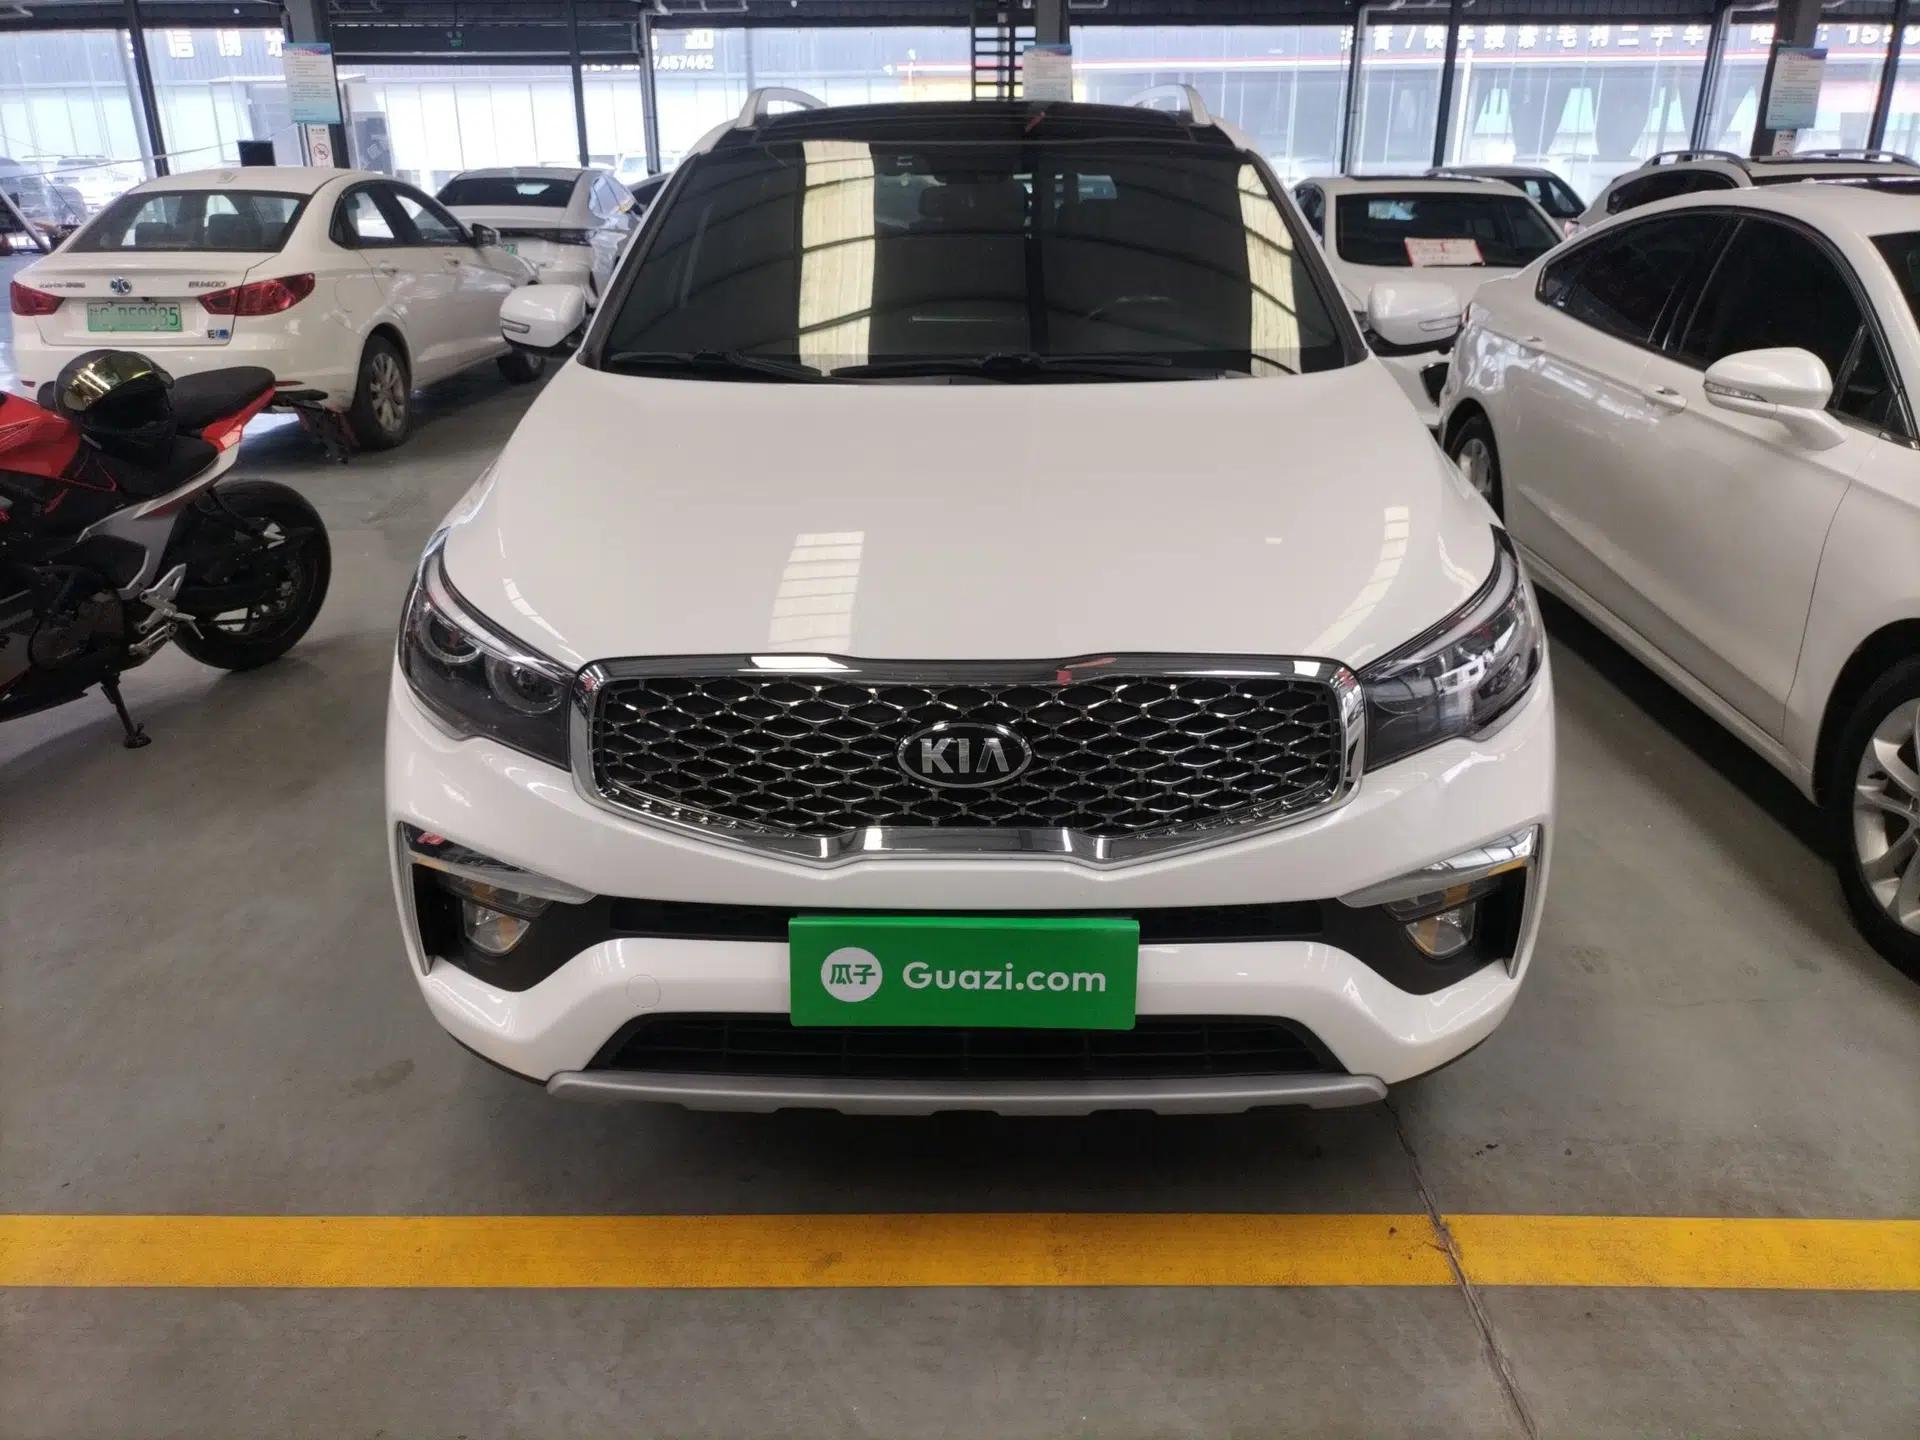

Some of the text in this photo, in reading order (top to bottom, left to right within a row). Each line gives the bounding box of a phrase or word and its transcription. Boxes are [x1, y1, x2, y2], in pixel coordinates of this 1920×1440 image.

[919, 736, 1010, 774] KIA
[828, 961, 1107, 993] 瓜子 Guazi.com
